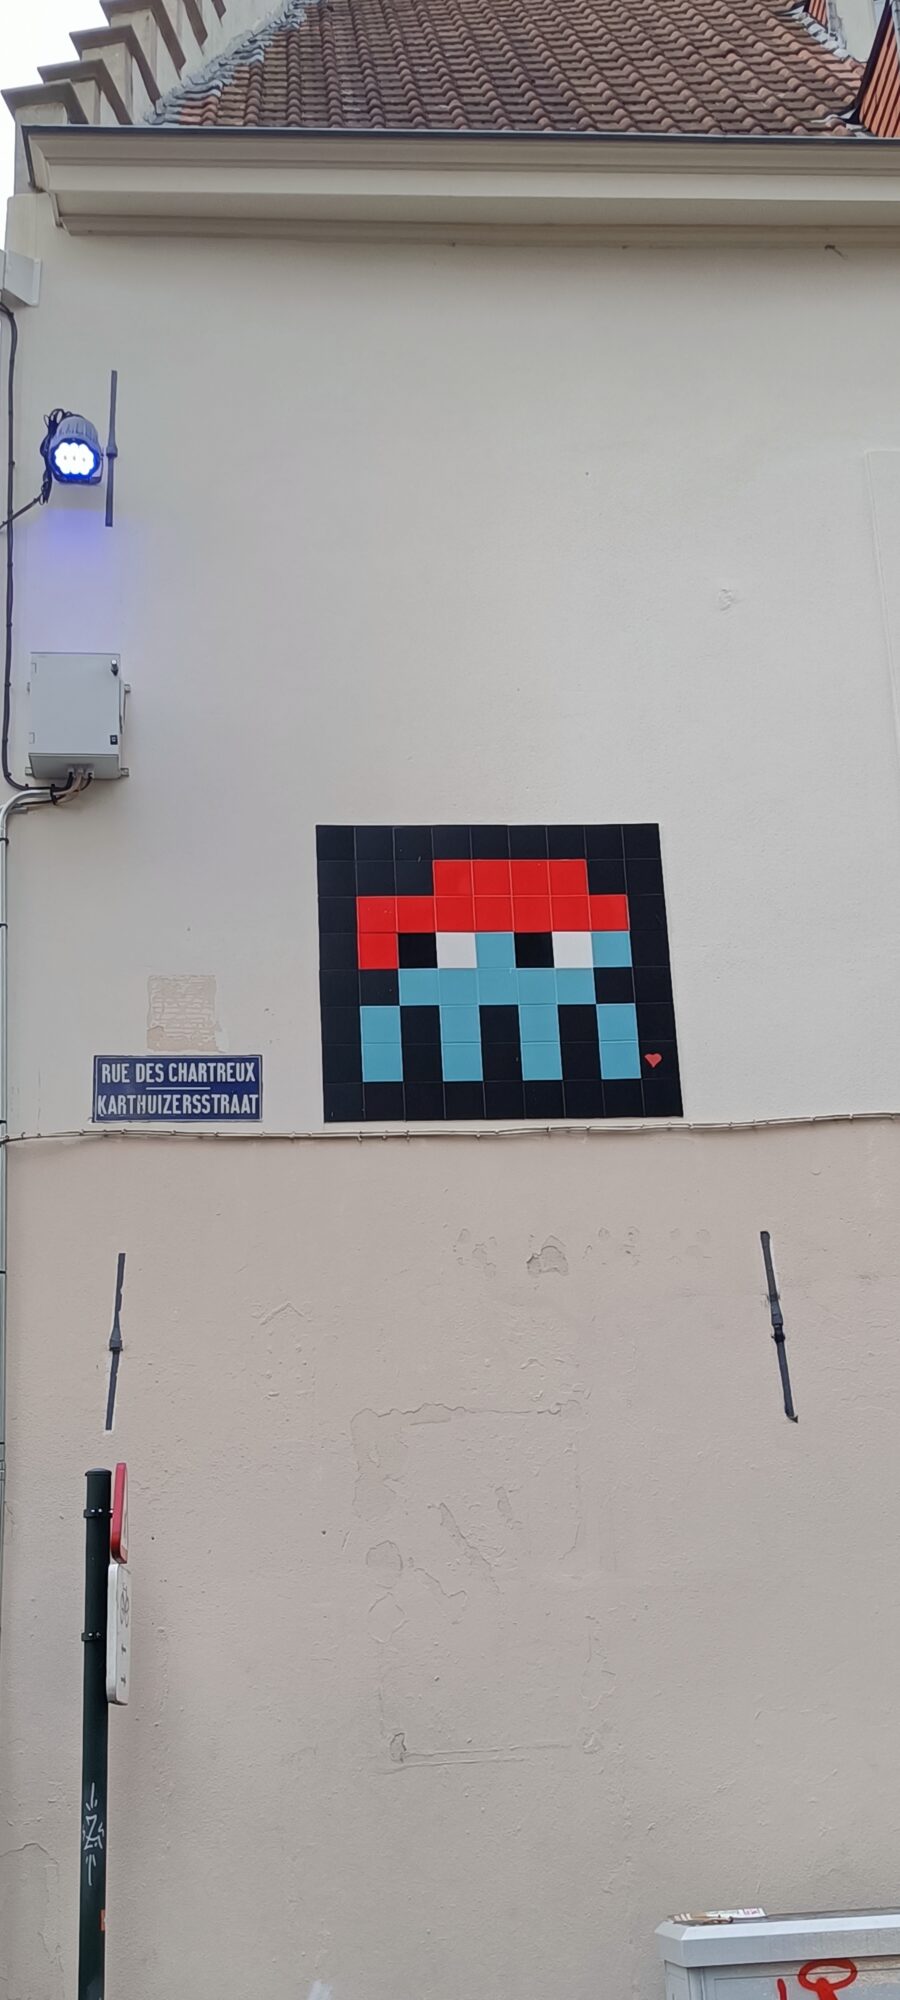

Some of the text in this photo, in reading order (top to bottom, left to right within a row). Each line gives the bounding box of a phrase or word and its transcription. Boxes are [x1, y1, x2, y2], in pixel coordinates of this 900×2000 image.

[101, 1062, 256, 1083] RUE DES CHARTREUX
[97, 1094, 259, 1115] KARTHUIZERSSTRAAT
